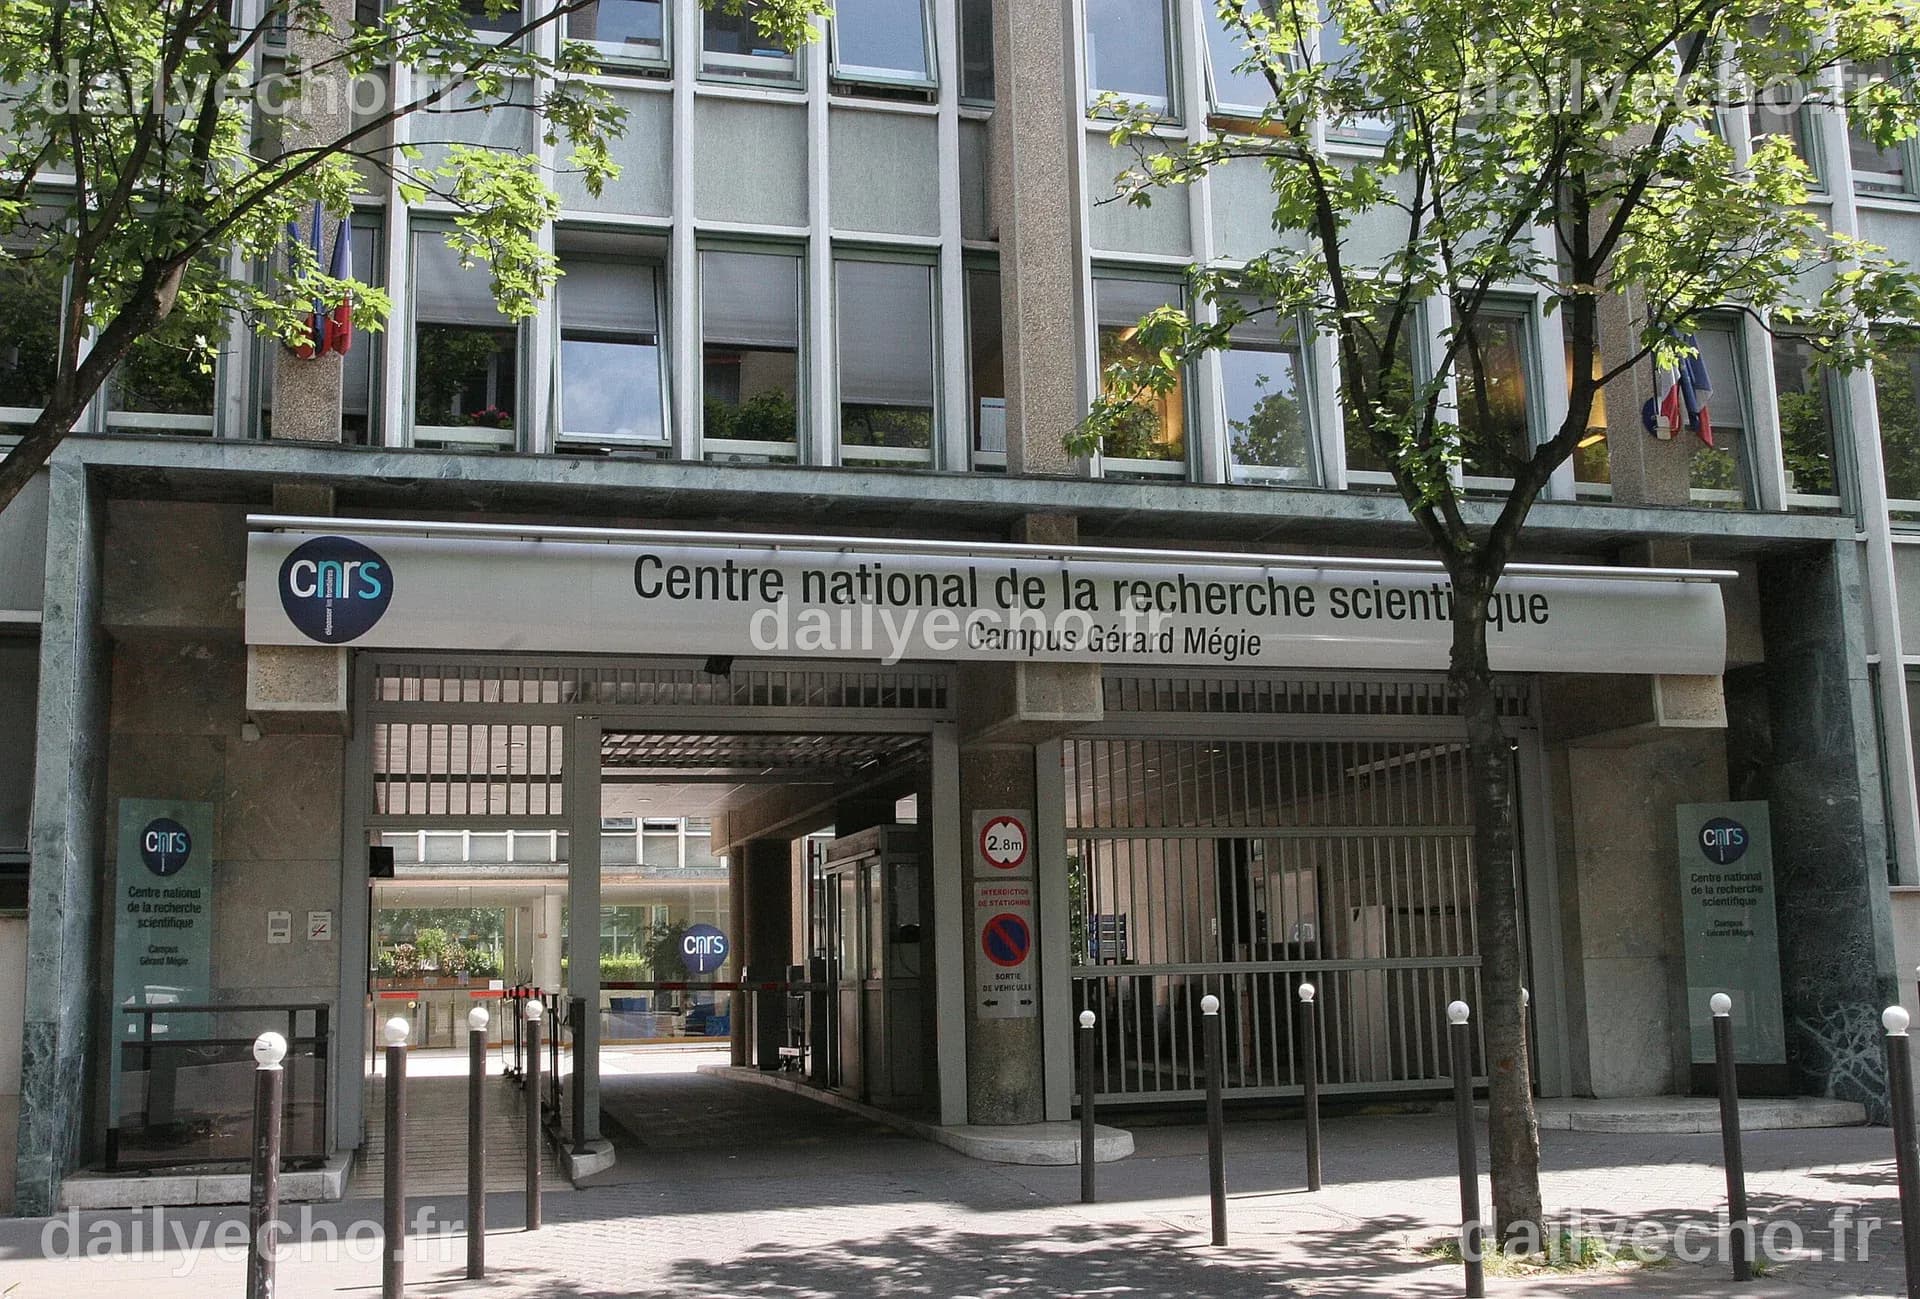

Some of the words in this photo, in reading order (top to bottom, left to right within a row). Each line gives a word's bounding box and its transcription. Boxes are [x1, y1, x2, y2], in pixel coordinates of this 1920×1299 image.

[289, 559, 382, 600] cnrs
[633, 554, 785, 603] Centre
[801, 562, 978, 608] national
[995, 567, 1046, 610] de
[1061, 569, 1099, 612] la
[1112, 573, 1316, 617] recherche
[1329, 579, 1549, 632] scientique
[967, 620, 1078, 657] Campus
[1087, 624, 1174, 654] Gérard
[1184, 626, 1262, 662] Mégie
[145, 831, 187, 853] cnrs
[1703, 828, 1744, 846] cnrs
[1691, 873, 1722, 883] Centre
[1724, 871, 1762, 882] national
[128, 885, 161, 899] Centre
[163, 887, 201, 899] national
[1691, 885, 1702, 896] de
[1705, 885, 1714, 895] la
[1716, 884, 1764, 895] recherche
[127, 901, 140, 914] de
[142, 902, 152, 913] la
[153, 902, 202, 914] recherche
[1702, 896, 1758, 907] scientifique
[138, 917, 194, 931] scientifique
[683, 935, 725, 955] cnrs
[995, 972, 1021, 981] SORTIE
